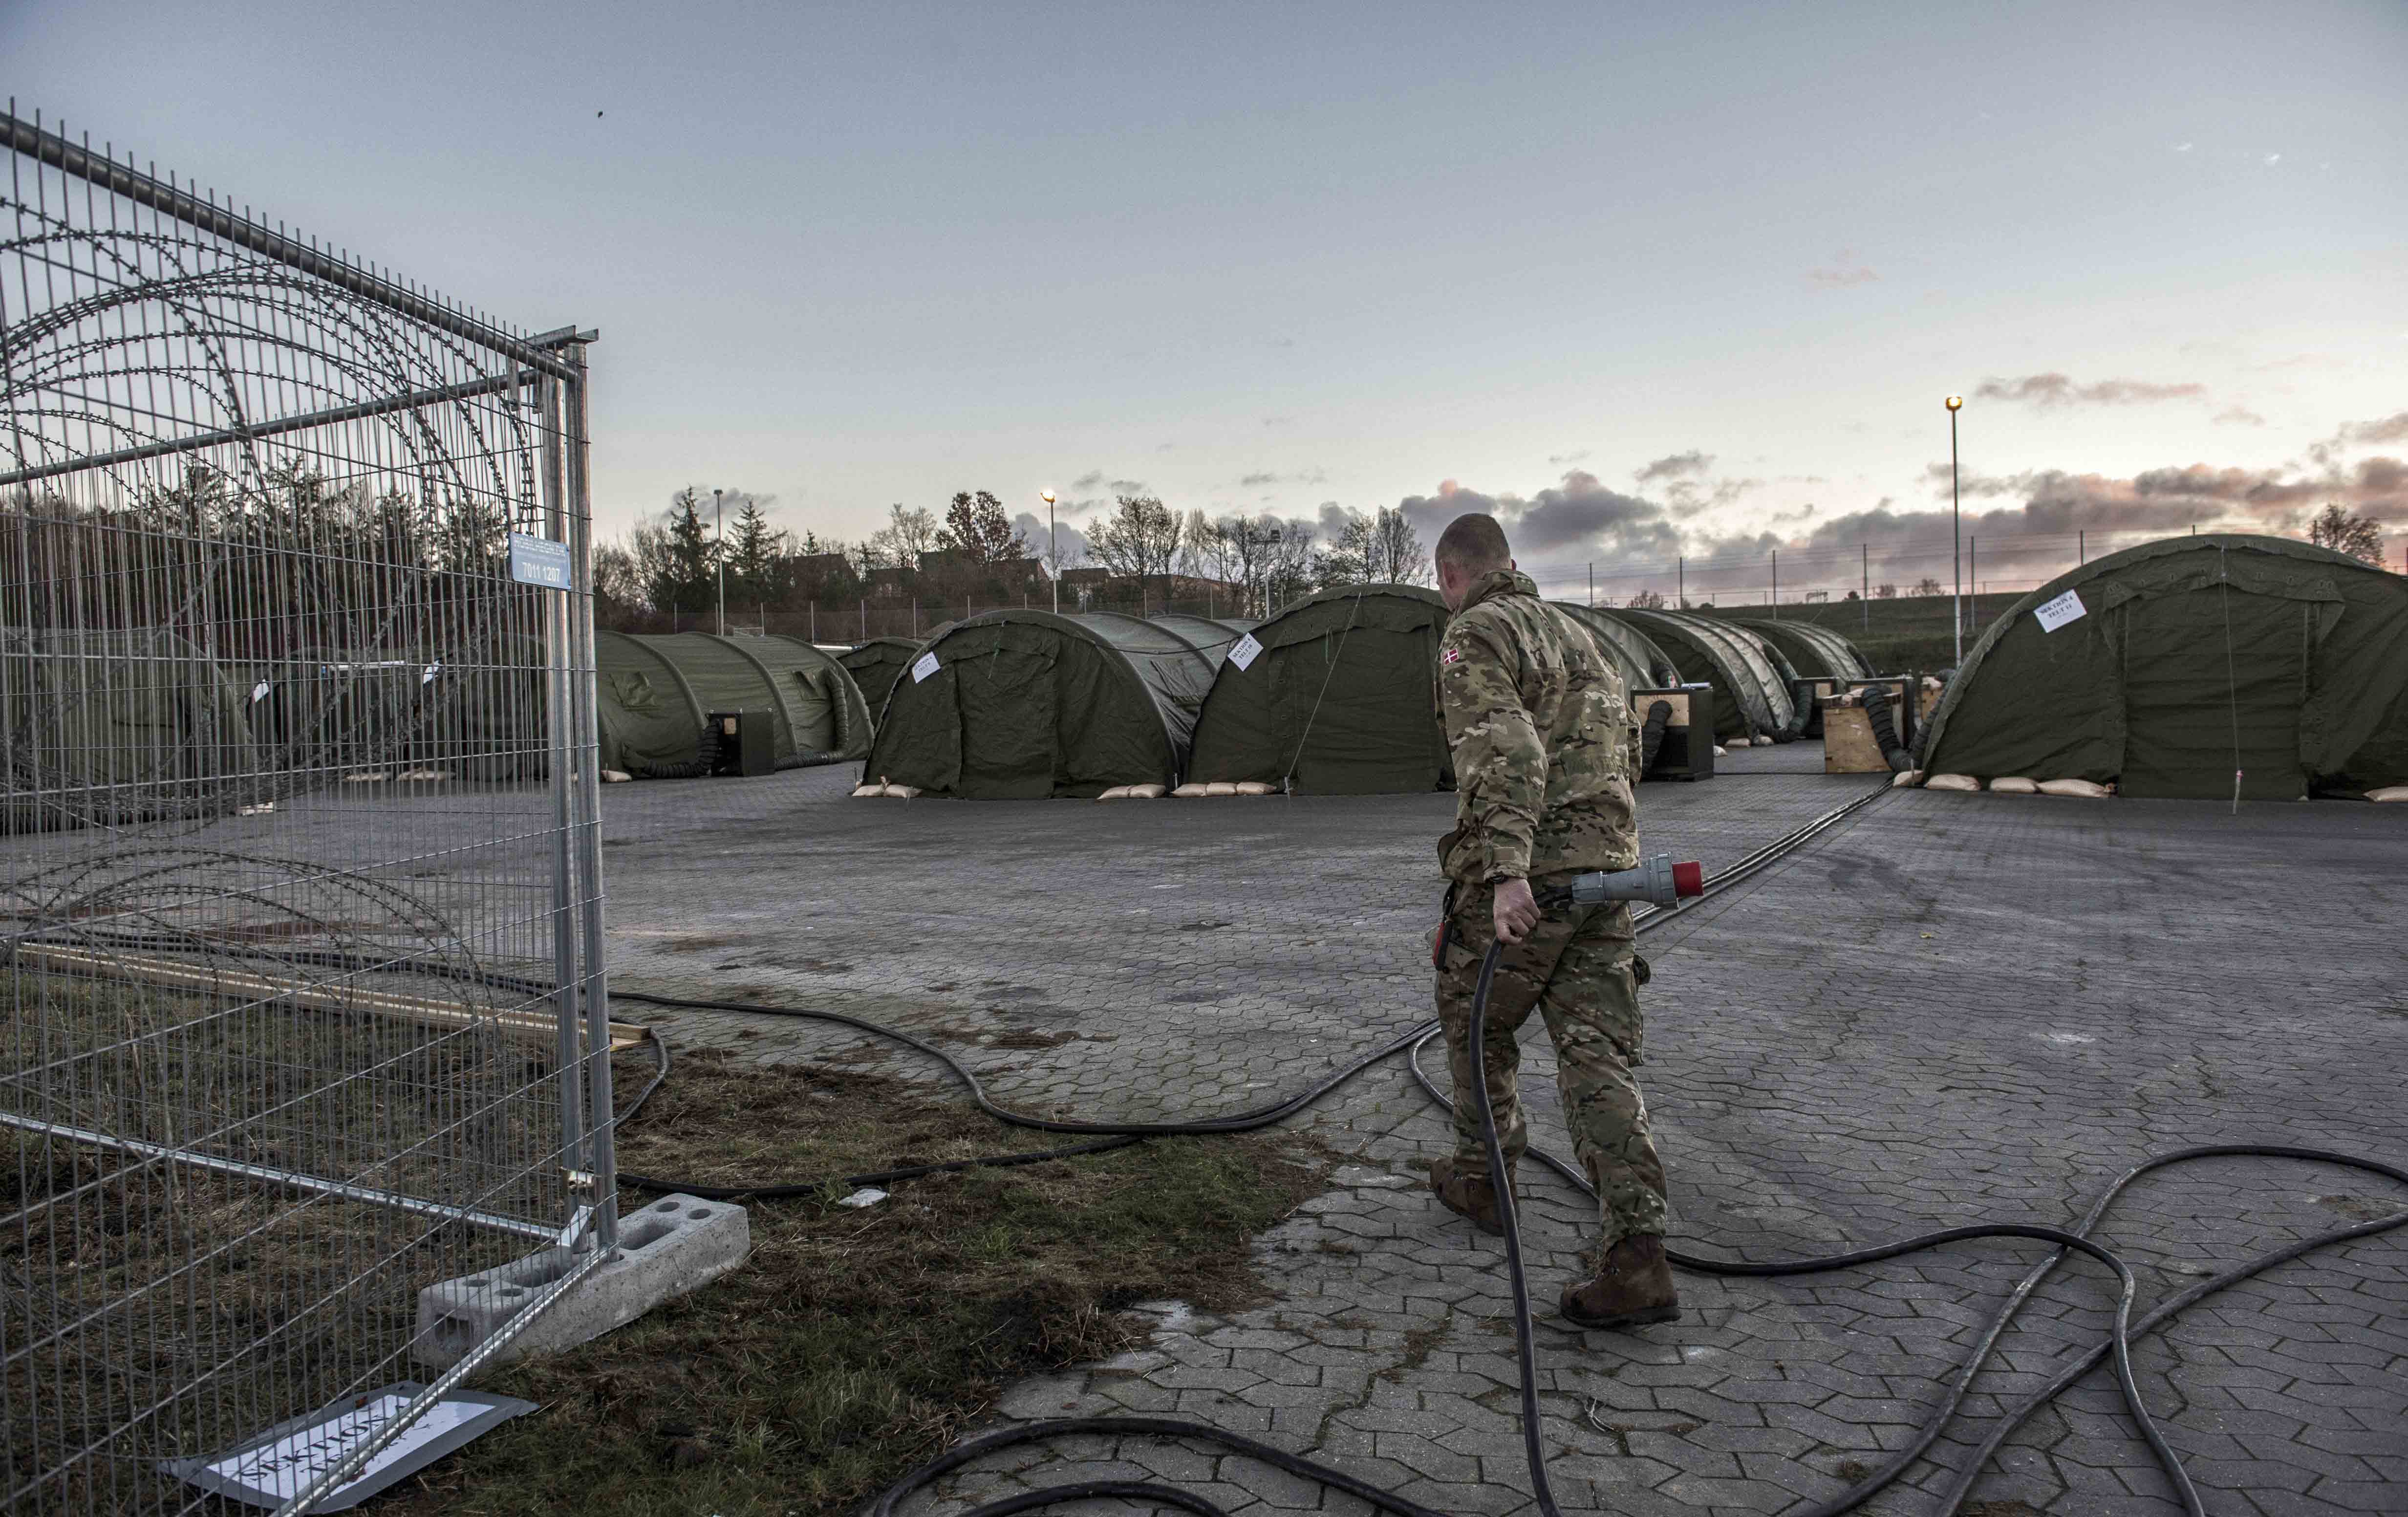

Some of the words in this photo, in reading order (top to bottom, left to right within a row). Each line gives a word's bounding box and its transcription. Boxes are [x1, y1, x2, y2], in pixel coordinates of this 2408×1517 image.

[521, 562, 540, 579] 7011
[543, 565, 560, 583] 1207
[2041, 598, 2068, 613] SEKTION
[1232, 641, 1248, 657] SEKTION
[239, 1414, 391, 1481] SEKTION
